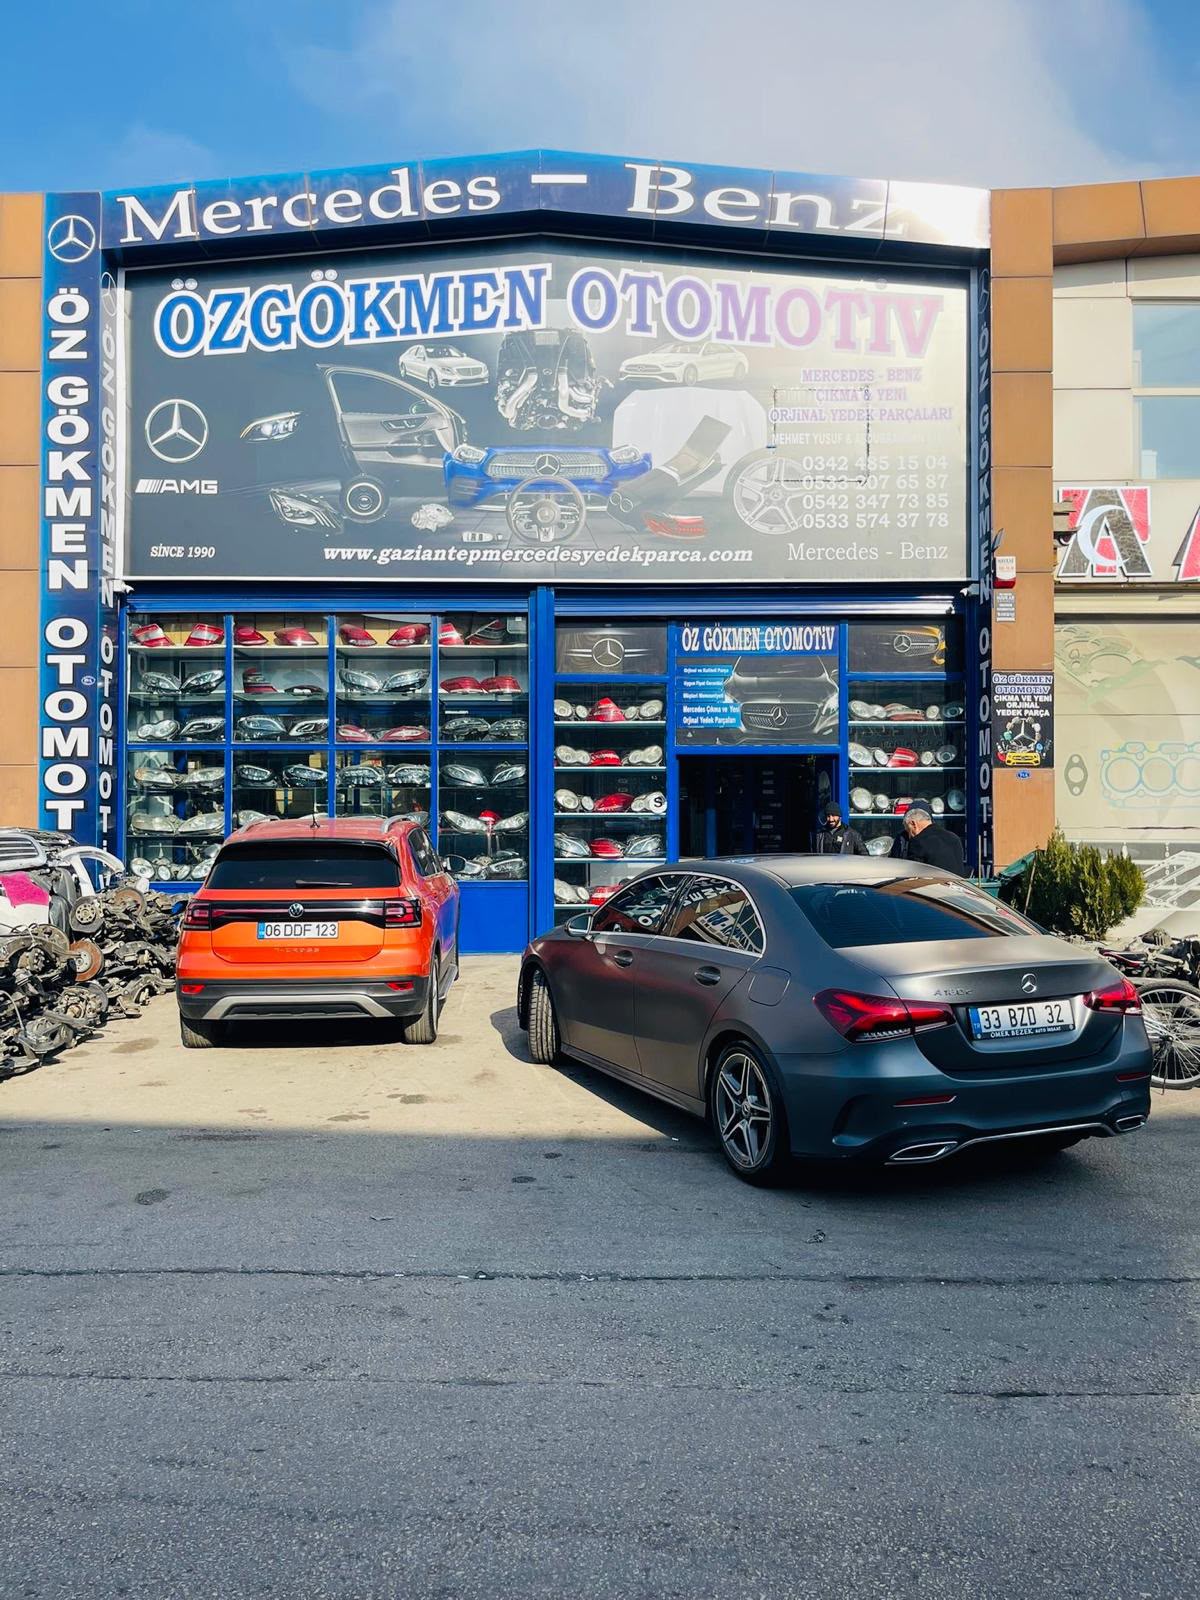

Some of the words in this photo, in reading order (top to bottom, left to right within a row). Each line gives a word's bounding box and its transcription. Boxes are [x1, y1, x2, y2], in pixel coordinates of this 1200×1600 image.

[116, 167, 501, 243] Mercedes
[624, 162, 906, 235] Benz
[153, 263, 553, 359] ÖZGÖKMEN
[47, 287, 90, 361] ÖZ
[802, 368, 875, 383] MERCEDES
[887, 367, 923, 382] BENZ
[815, 387, 859, 405] ÇIKMA
[830, 407, 874, 422] YEDEK
[878, 405, 953, 425] PARÇALARI
[772, 432, 811, 445] MEHMET
[802, 455, 849, 471] 0342
[897, 455, 920, 471] 15
[925, 454, 950, 471] 04
[45, 376, 92, 590] GÖKMEN
[161, 479, 218, 495] AMG
[896, 474, 920, 490] 65
[926, 474, 949, 490] 87
[802, 494, 849, 510] 0542
[855, 494, 890, 510] 347
[896, 494, 920, 509] 73
[926, 493, 949, 509] 85
[802, 513, 849, 529] 0533
[855, 513, 891, 529] 574
[896, 513, 920, 528] 37
[926, 512, 949, 528] 78
[187, 546, 215, 559] 1990
[323, 545, 753, 567] www.gaziantepmercedesyedekparca.com
[787, 542, 879, 561] Mercedes
[899, 541, 949, 560] Benz
[681, 621, 700, 652] ÖZ
[703, 621, 761, 652] GÖKMEN
[1008, 673, 1053, 684] GÖKMEN
[683, 705, 706, 713] Mercedes
[1024, 709, 1050, 717] PARÇA
[42, 617, 89, 830] OTOMOT
[265, 924, 281, 937] 06
[283, 924, 312, 937] DDF
[315, 923, 337, 937] 123
[981, 1010, 1002, 1030] 33
[1008, 1007, 1037, 1028] BZD
[1044, 1004, 1064, 1023] 32
